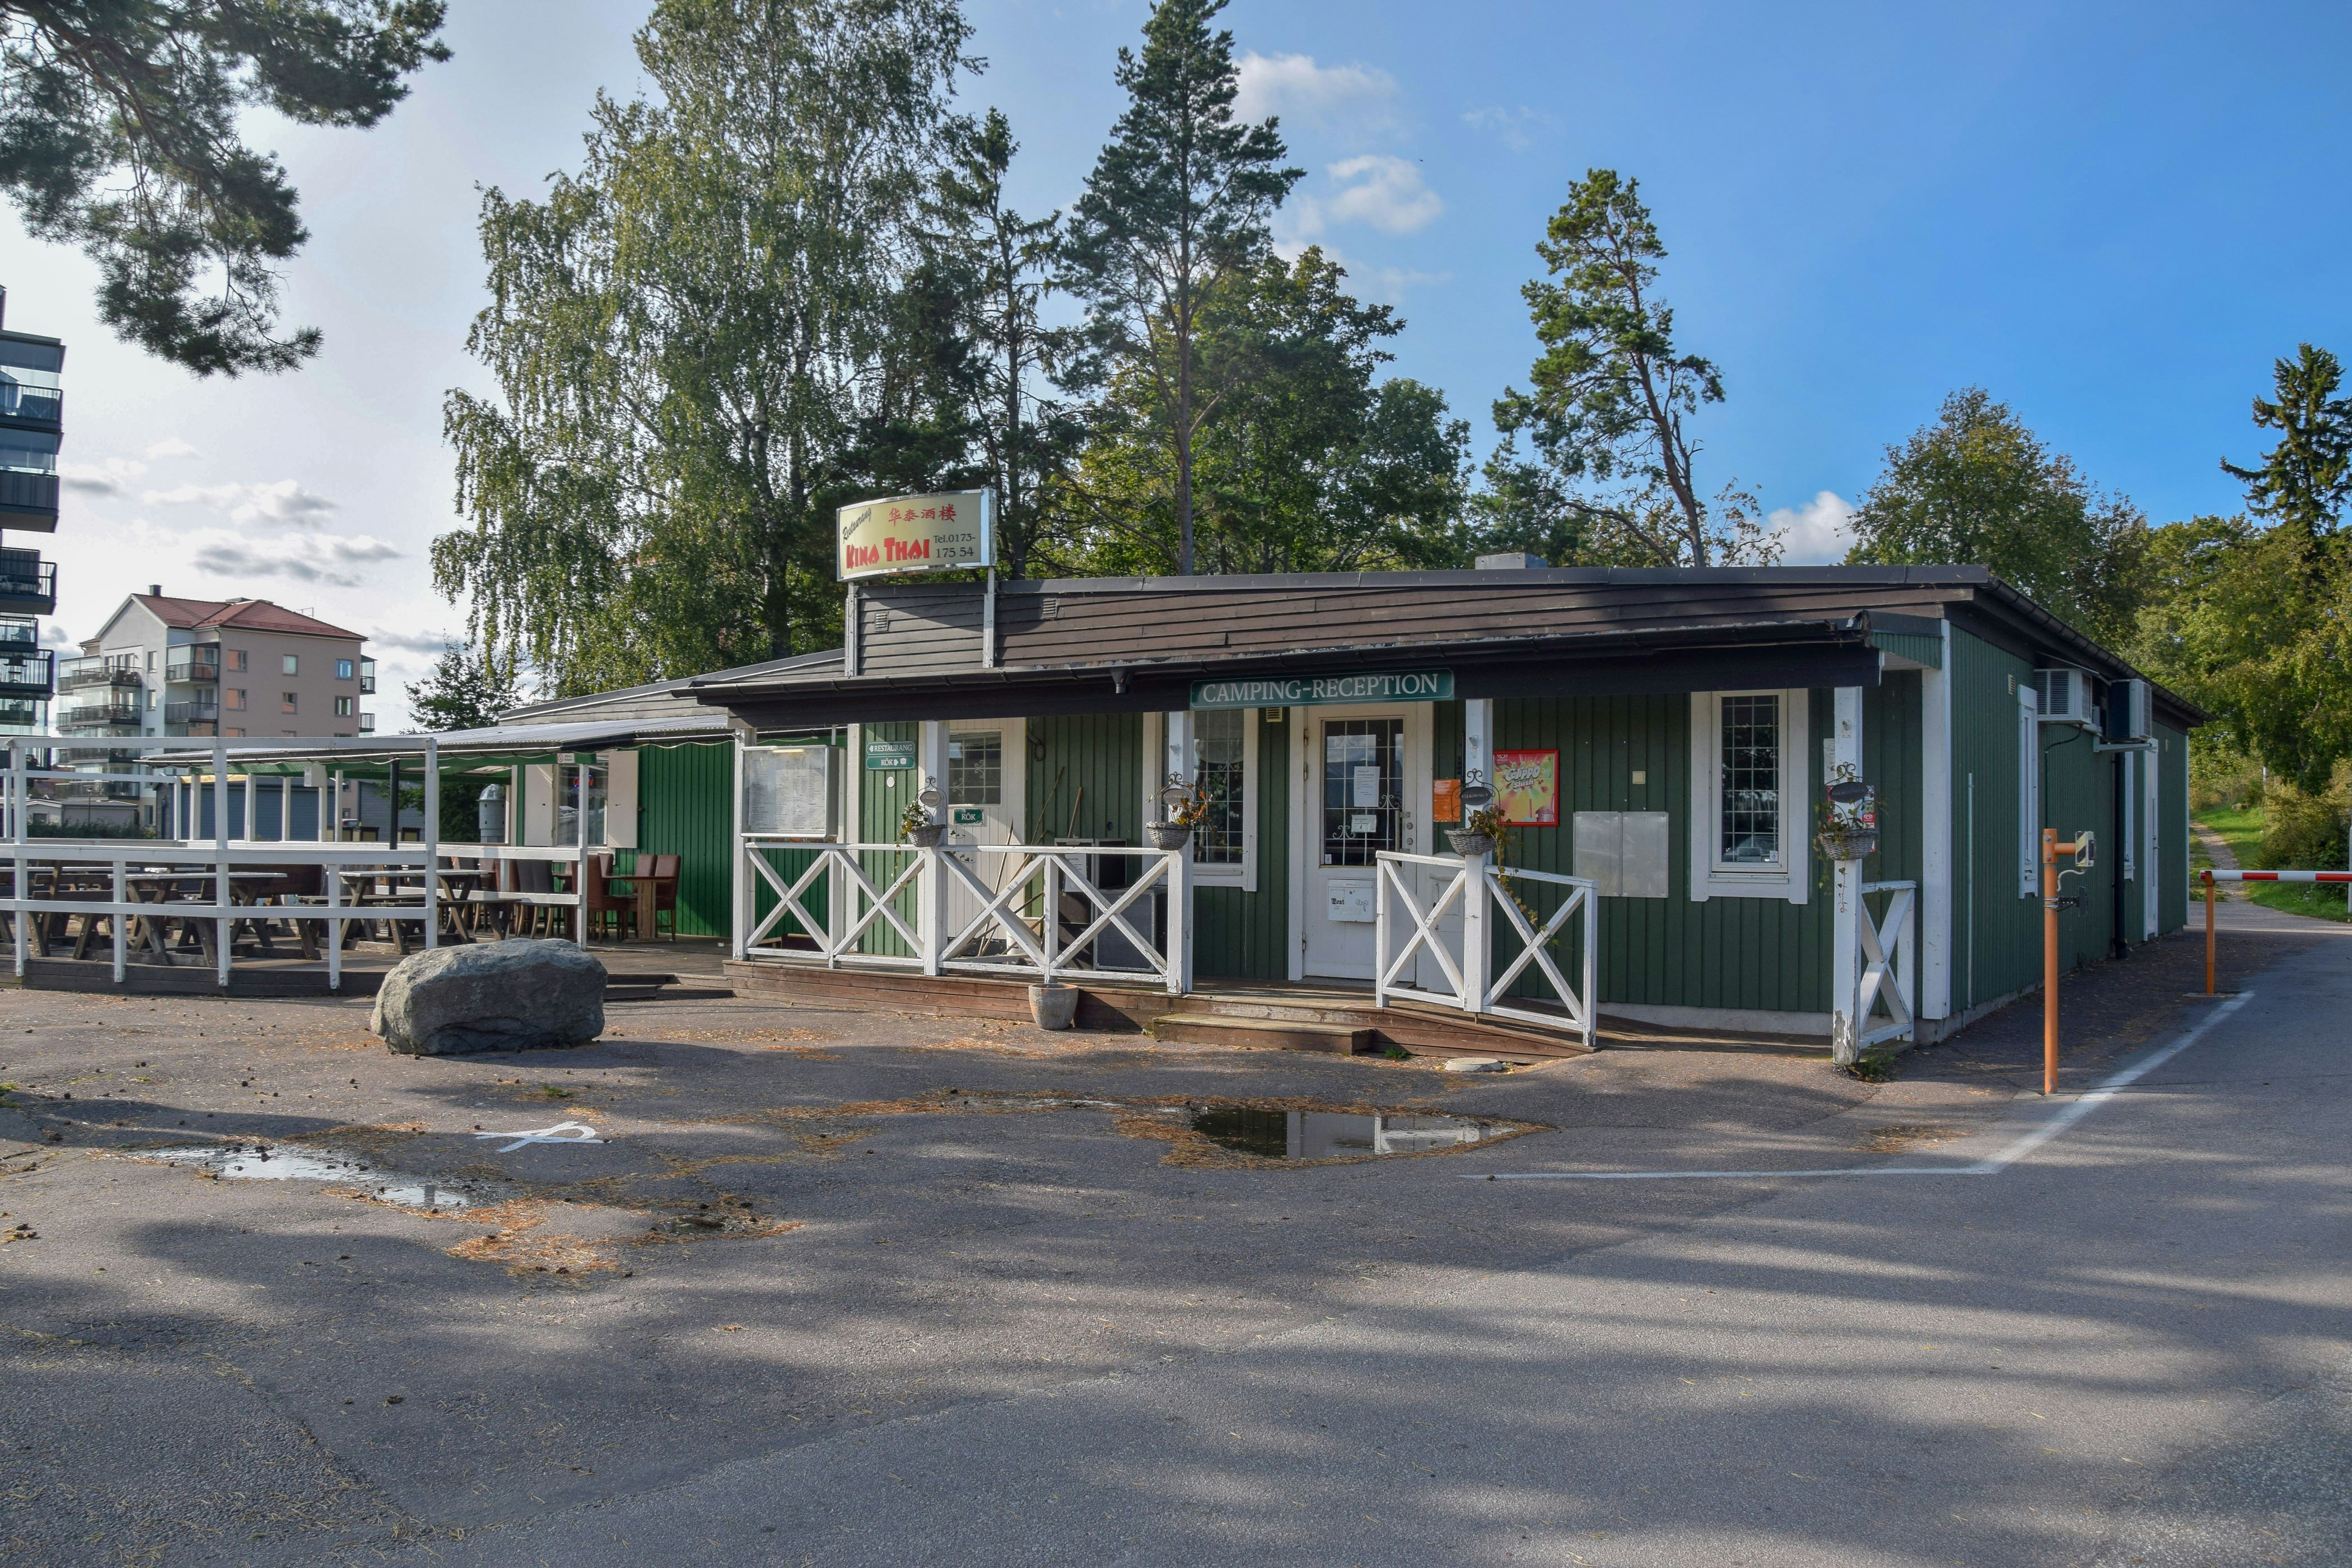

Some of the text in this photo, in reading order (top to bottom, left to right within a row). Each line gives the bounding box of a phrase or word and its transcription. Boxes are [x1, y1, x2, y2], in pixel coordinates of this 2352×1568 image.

[888, 503, 956, 526] 华泰酒楼
[842, 507, 872, 544] Restaurang
[933, 533, 976, 543] Tel.0173-
[936, 547, 974, 558] 175 54
[1202, 674, 1439, 703] CAMPING-RECEPTION
[881, 758, 894, 766] KÖK
[961, 812, 976, 820] KÖK
